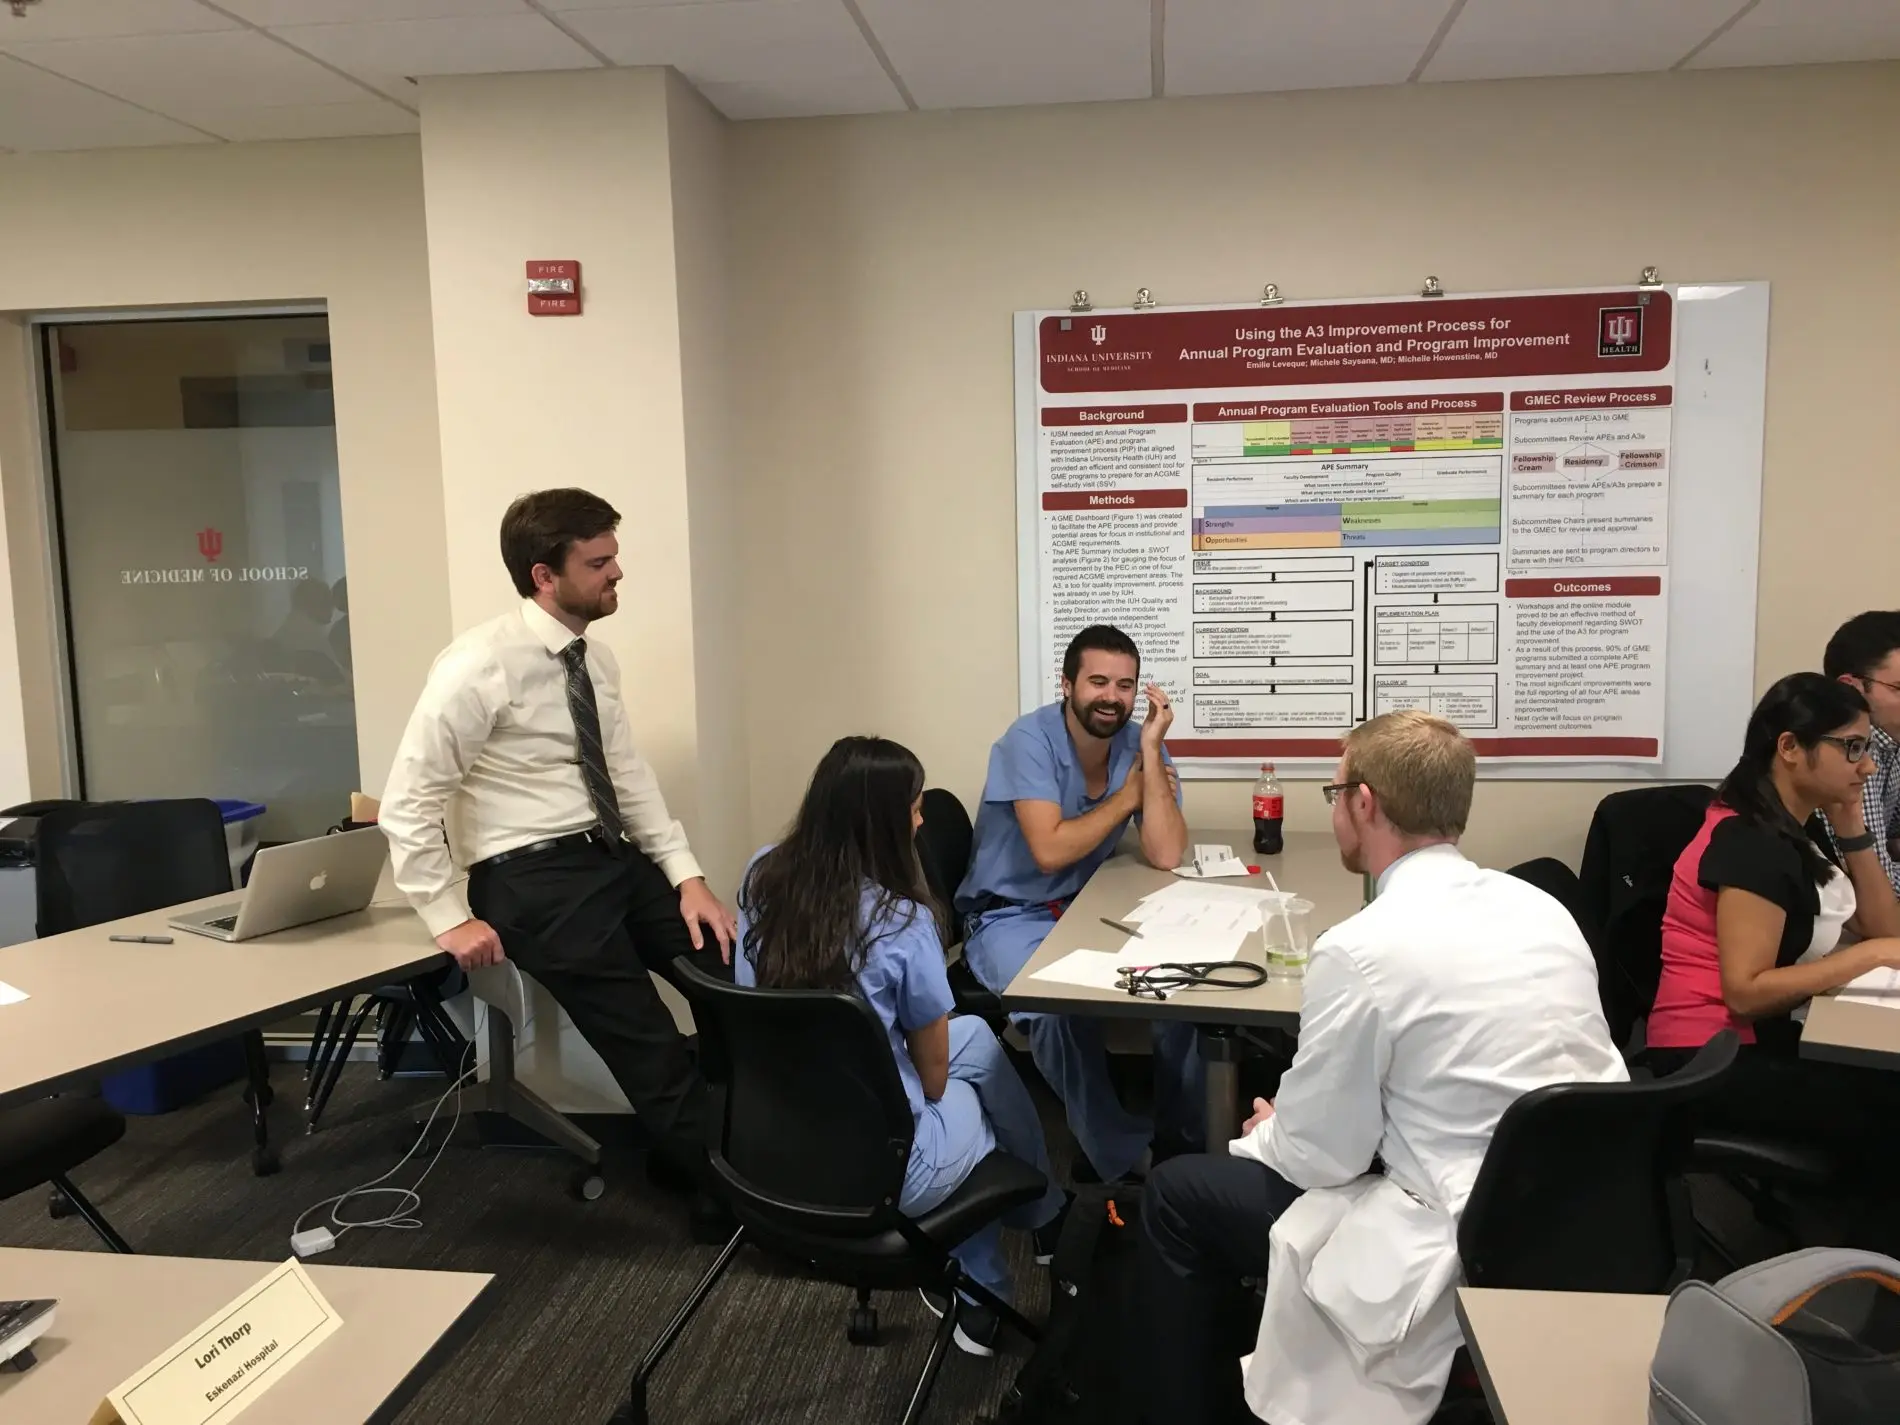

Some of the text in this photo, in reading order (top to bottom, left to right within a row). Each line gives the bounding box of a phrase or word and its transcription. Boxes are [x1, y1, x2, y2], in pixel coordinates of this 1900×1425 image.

[1235, 317, 1511, 343] Using the A3 Improvement Process for
[1179, 333, 1570, 361] Annual Program Evaluation and Program Improvement
[1602, 345, 1638, 354] HEALTH
[1046, 351, 1152, 363] INDIANA UNIVERSITY
[1246, 360, 1270, 368] Emilie
[1272, 359, 1308, 369] Leveque;
[1310, 358, 1340, 366] Michele
[1342, 357, 1378, 367] Saysana,
[1380, 356, 1396, 365] MD;
[1398, 354, 1431, 362] Michelle
[1433, 352, 1482, 363] Howenstine,
[1524, 392, 1656, 405] GMEC Review Process
[1218, 398, 1477, 417] Annual Program Evaluation Tools and Process
[1079, 410, 1145, 423] Background
[1515, 416, 1548, 425] Programs
[1128, 428, 1156, 436] Program
[1084, 438, 1104, 446] (APE)
[1090, 455, 1121, 463] University
[1145, 454, 1162, 462] (IUH)
[1513, 455, 1554, 464] Fellowship
[1620, 451, 1662, 460] Fellowship
[1565, 457, 1603, 466] Residency
[1625, 460, 1657, 468] Crimson
[1336, 463, 1369, 472] Summary
[1051, 481, 1081, 489] self-study
[1096, 481, 1116, 489] (SSV)
[1089, 495, 1135, 505] Methods
[1111, 513, 1133, 522] (Figure
[1343, 516, 1381, 524] Weaknesses
[1205, 520, 1234, 530] Strengths
[1205, 535, 1247, 546] Opportunities
[1081, 548, 1111, 556] Summary
[1553, 581, 1611, 592] Outcomes
[1516, 620, 1537, 628] faculty
[1539, 620, 1583, 628] development
[1585, 619, 1618, 627] regarding
[194, 1322, 252, 1369] Lori Thorp
[205, 1339, 279, 1402] Eskenazi Hospital
